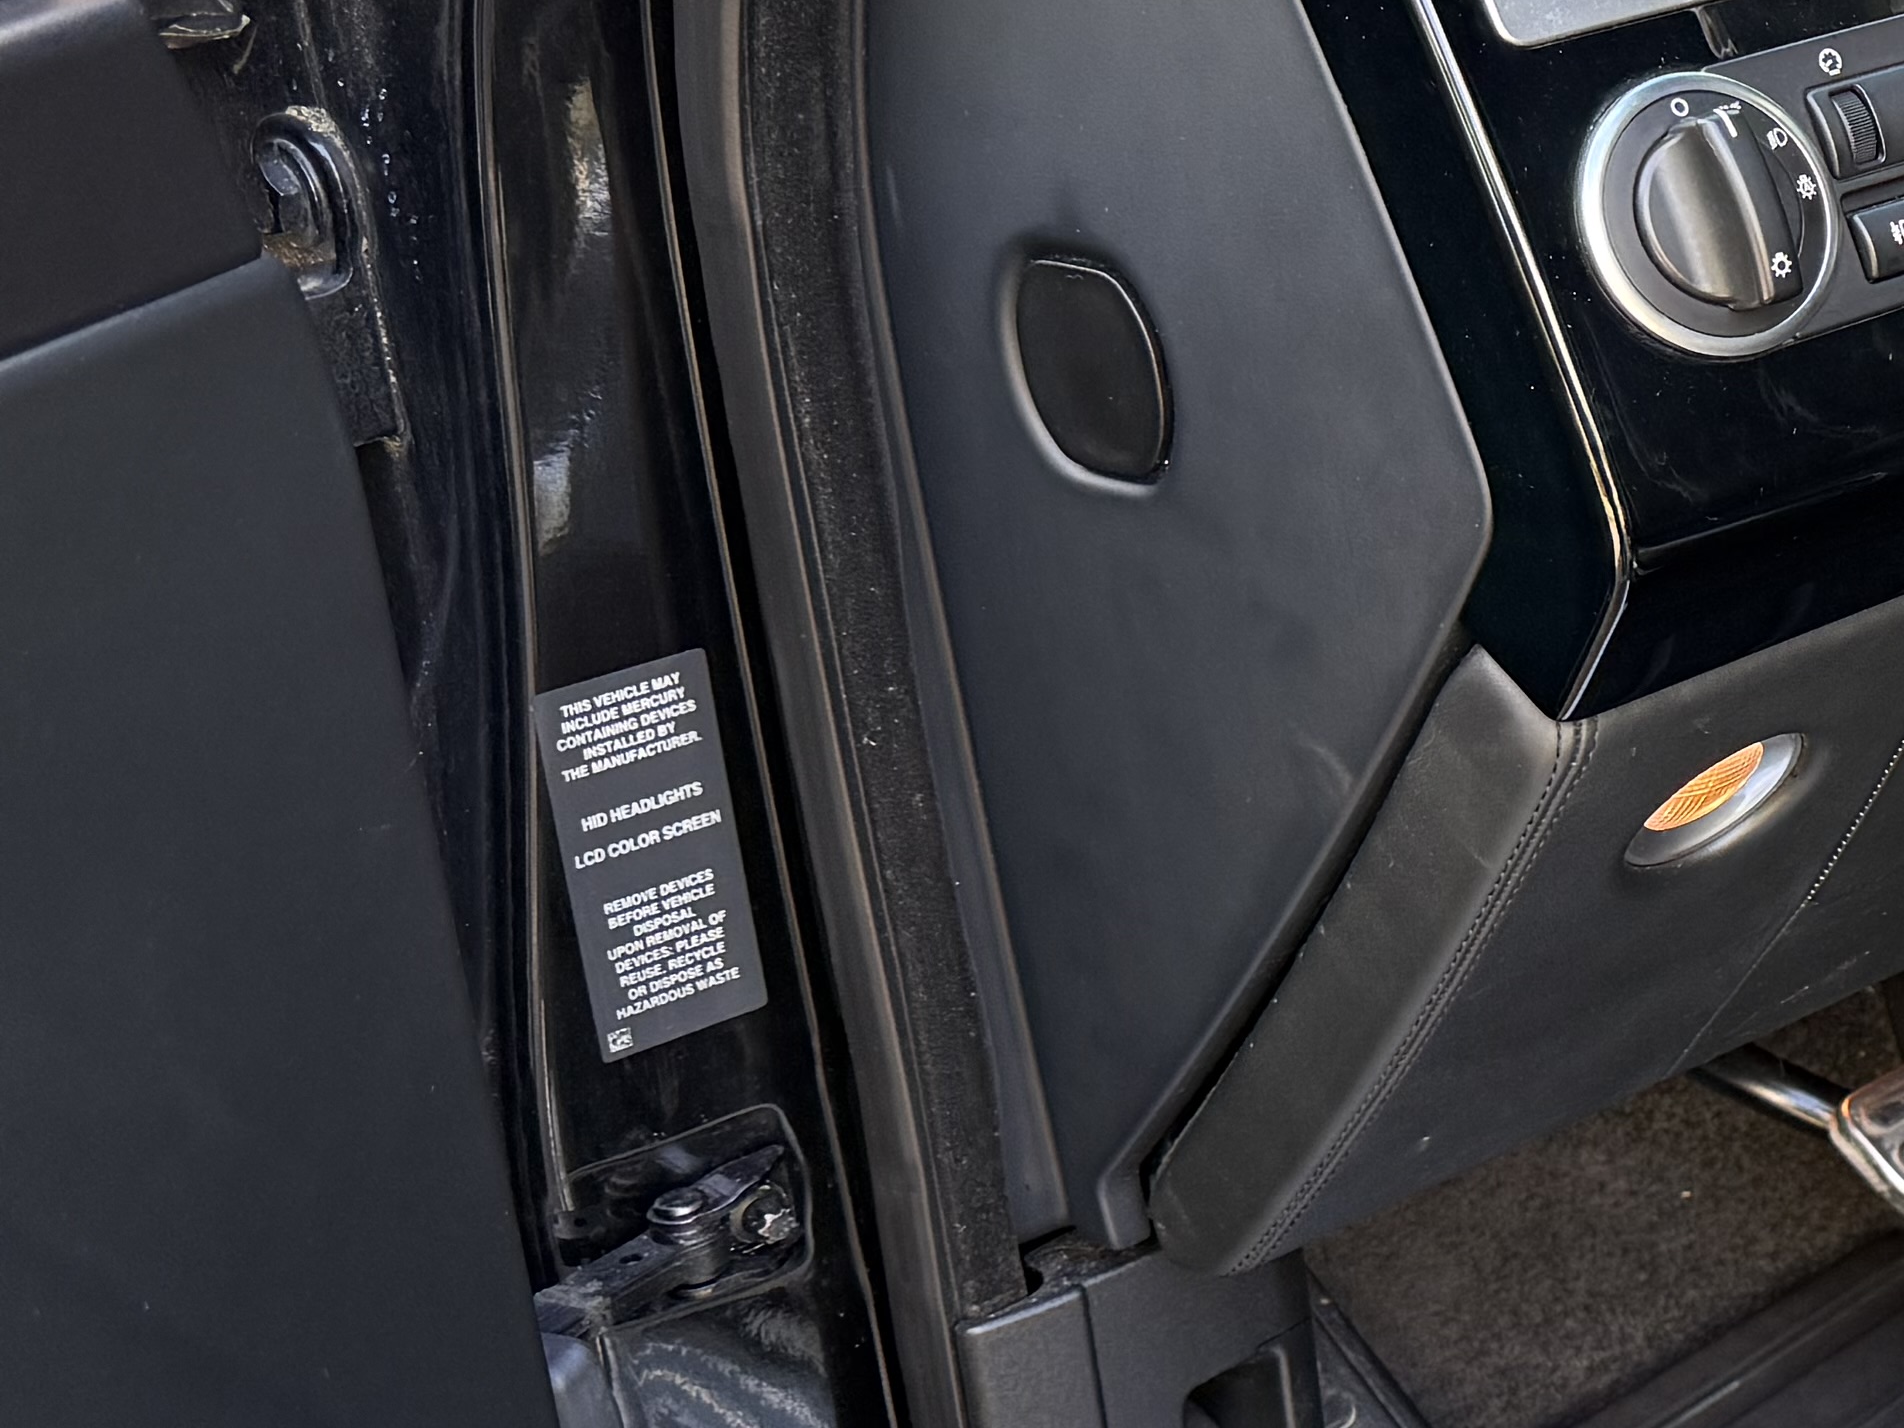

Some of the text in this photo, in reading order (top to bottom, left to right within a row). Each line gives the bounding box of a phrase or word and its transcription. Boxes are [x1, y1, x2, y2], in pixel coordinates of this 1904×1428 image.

[560, 672, 680, 717] THIS VEHICLE MAY
[561, 686, 685, 734] INCLUDE MERCURY
[556, 699, 697, 752] CONTAINING DEVICES
[583, 721, 676, 760] INSTALLED BY
[561, 731, 703, 782] THE MANUFACTURER.
[581, 781, 704, 832] HID HEADLIGHTS
[574, 809, 722, 870] LCD COLOR SCREEN
[603, 868, 714, 915] REMOVE DEVICES
[607, 883, 716, 930] BEFORE VEHICLE
[607, 910, 726, 961] UPON REMOVAL OF
[633, 906, 697, 937] DISPOSAL
[675, 926, 725, 952] PLEASE
[667, 941, 726, 970] RECYCLE
[616, 967, 741, 1020] HAZARDOUS WASTE
[627, 958, 724, 1001] OR DISPOSE AS
